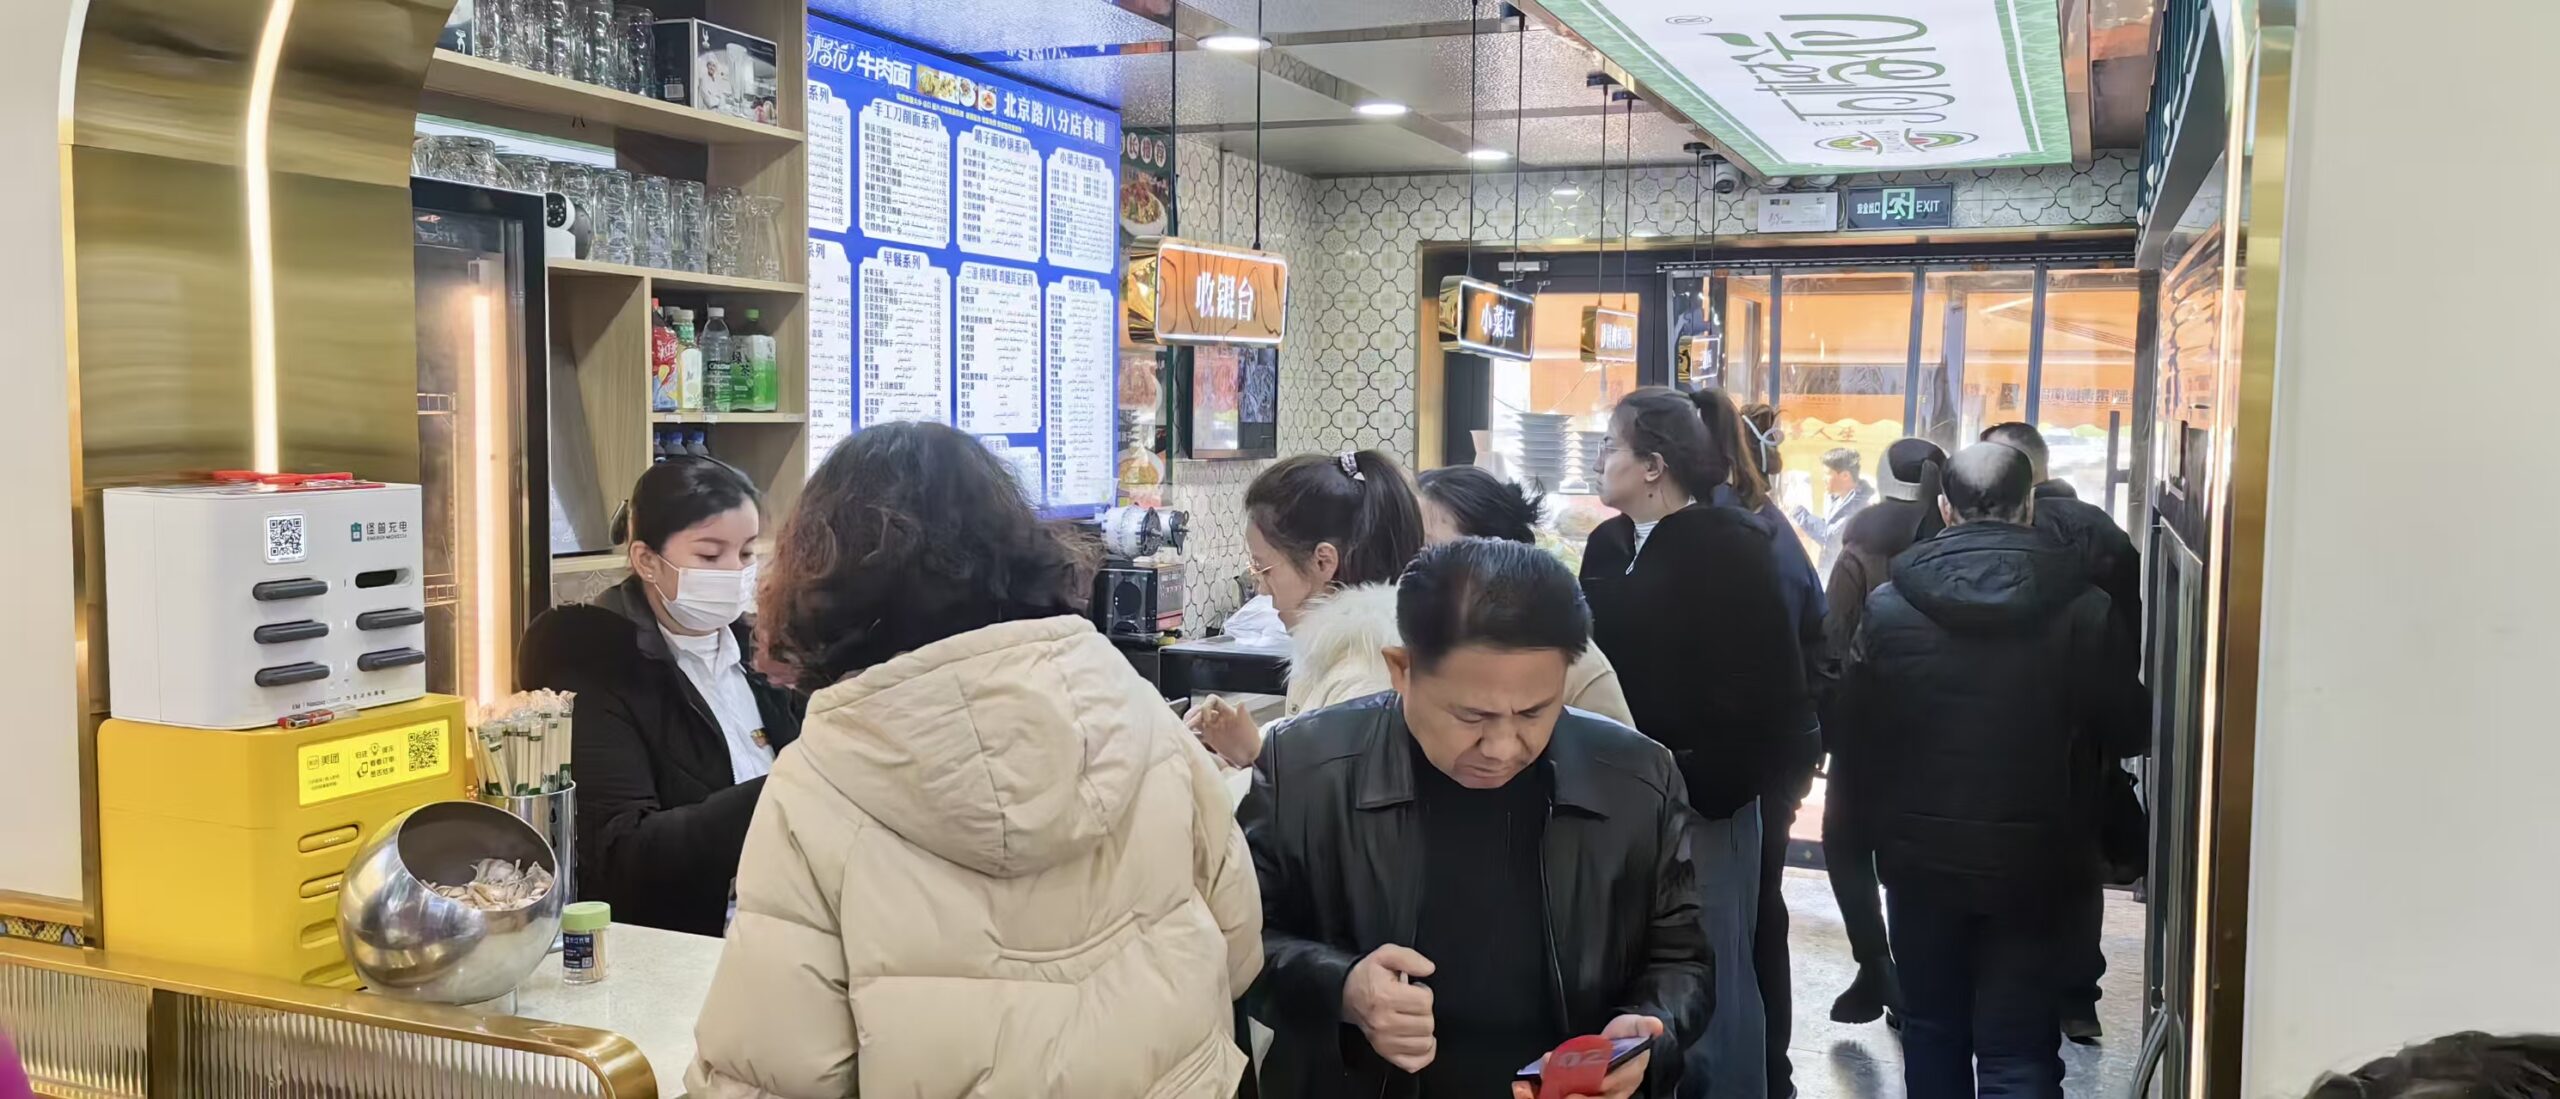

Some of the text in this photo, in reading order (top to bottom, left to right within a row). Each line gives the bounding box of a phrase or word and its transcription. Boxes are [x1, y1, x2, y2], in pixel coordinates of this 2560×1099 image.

[857, 50, 912, 90] 牛肉面
[873, 102, 939, 131] 手工刀削面系列
[1004, 91, 1105, 145] 北京路八分店食谱
[1857, 200, 1940, 214] 安全出口 EXIT
[884, 250, 921, 270] 早餐系列
[1195, 271, 1254, 322] 收银台
[1480, 305, 1517, 339] 小菜区
[366, 521, 408, 535] 怪兽充电
[321, 751, 340, 765] 美团
